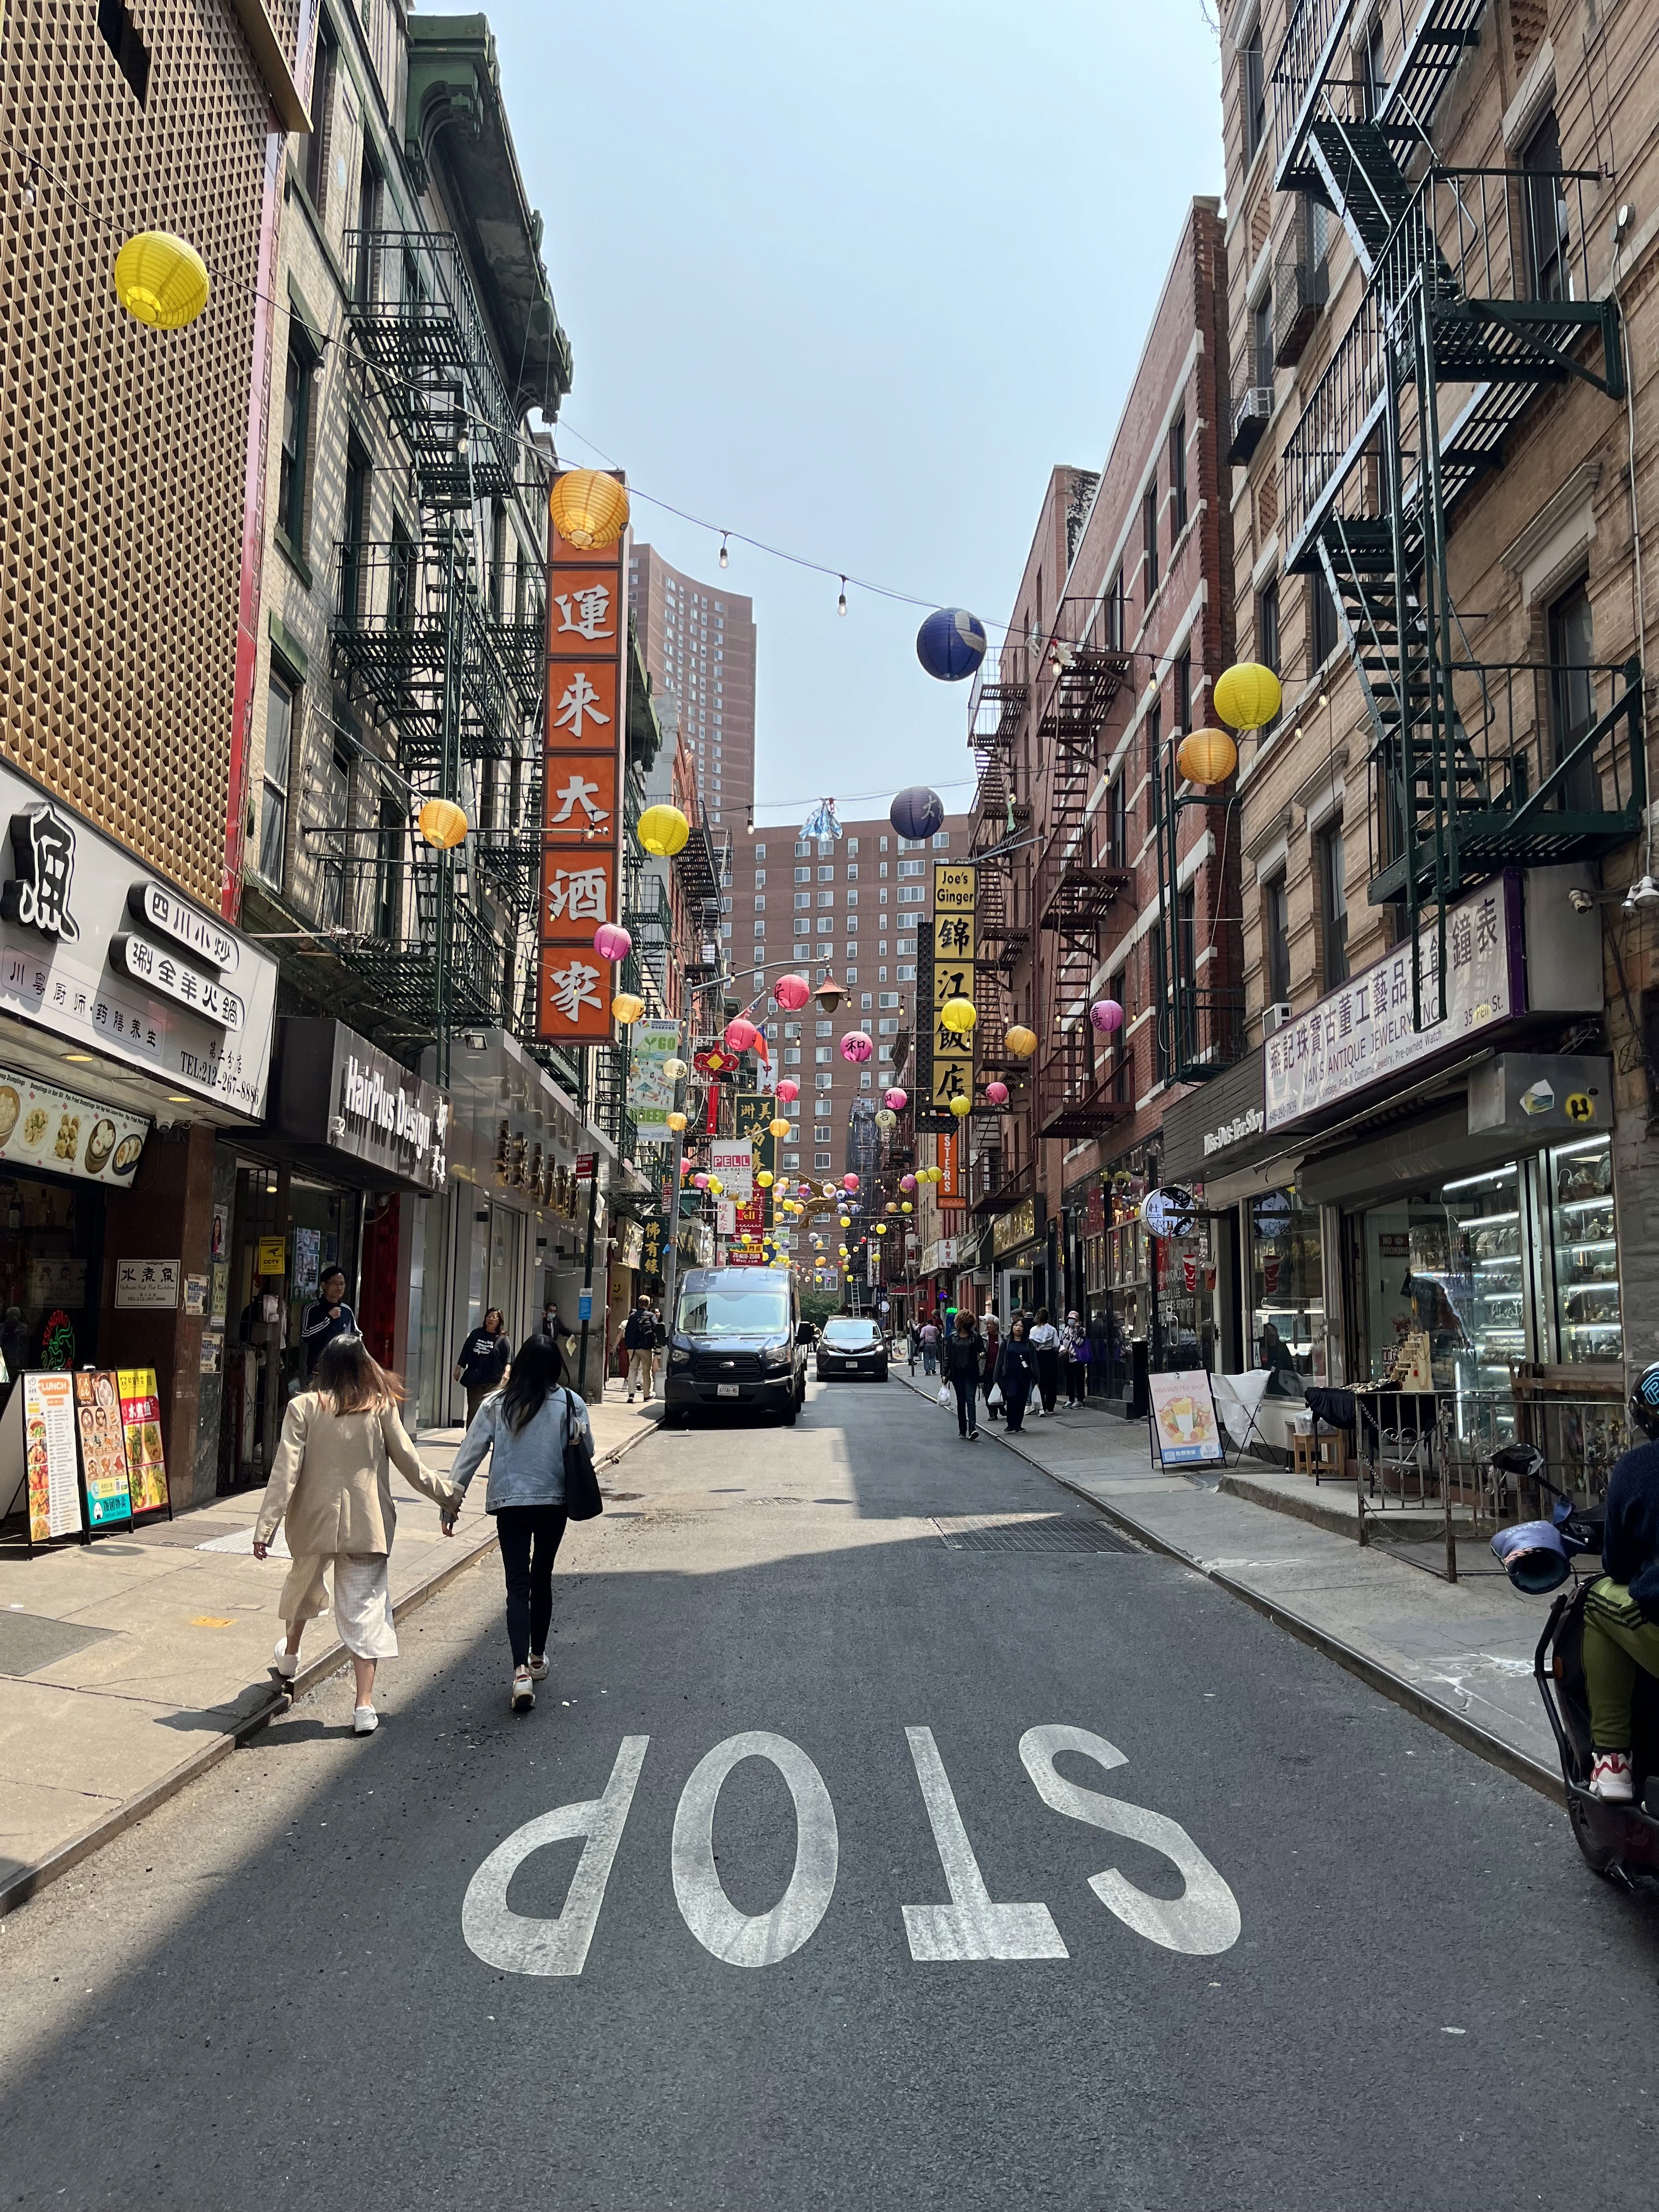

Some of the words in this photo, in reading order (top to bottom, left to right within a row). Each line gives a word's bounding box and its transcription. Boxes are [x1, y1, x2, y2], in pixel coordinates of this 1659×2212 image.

[550, 583, 613, 1023] 運來大酒家
[942, 871, 968, 885] Joe's
[936, 889, 974, 905] Ginger
[152, 891, 230, 963] 四川小炒
[133, 943, 238, 1026] 涮全羊火鍋
[1464, 1008, 1472, 1026] 35
[1476, 1000, 1488, 1021] Pell
[1492, 994, 1503, 1012] St.
[658, 1037, 676, 1050] GO
[1304, 1061, 1324, 1088] YAN'S
[1328, 1038, 1366, 1076] ANTIQUE
[1371, 1010, 1414, 1054] JEWELRY
[1355, 1065, 1372, 1082] Costume
[1375, 1055, 1395, 1074] Jewelry,
[1396, 1040, 1423, 1061] Pre-owned
[1425, 1029, 1442, 1046] Watch
[180, 1051, 259, 1105] TEL:212-267-8886
[396, 1087, 431, 1160] Design
[630, 1108, 667, 1122] GREEN
[1232, 1118, 1250, 1141] Tea
[1246, 1109, 1265, 1133] Shop
[714, 1155, 750, 1167] PELL
[645, 1221, 661, 1274] 佛有緣
[1380, 1246, 1409, 1255] SMOKING
[1382, 1236, 1392, 1245] NO
[121, 1267, 174, 1283] 水煮魚
[42, 1310, 69, 1346] TSINGTAO
[41, 1382, 66, 1391] LUNCH
[462, 1724, 1242, 1976] STOP
